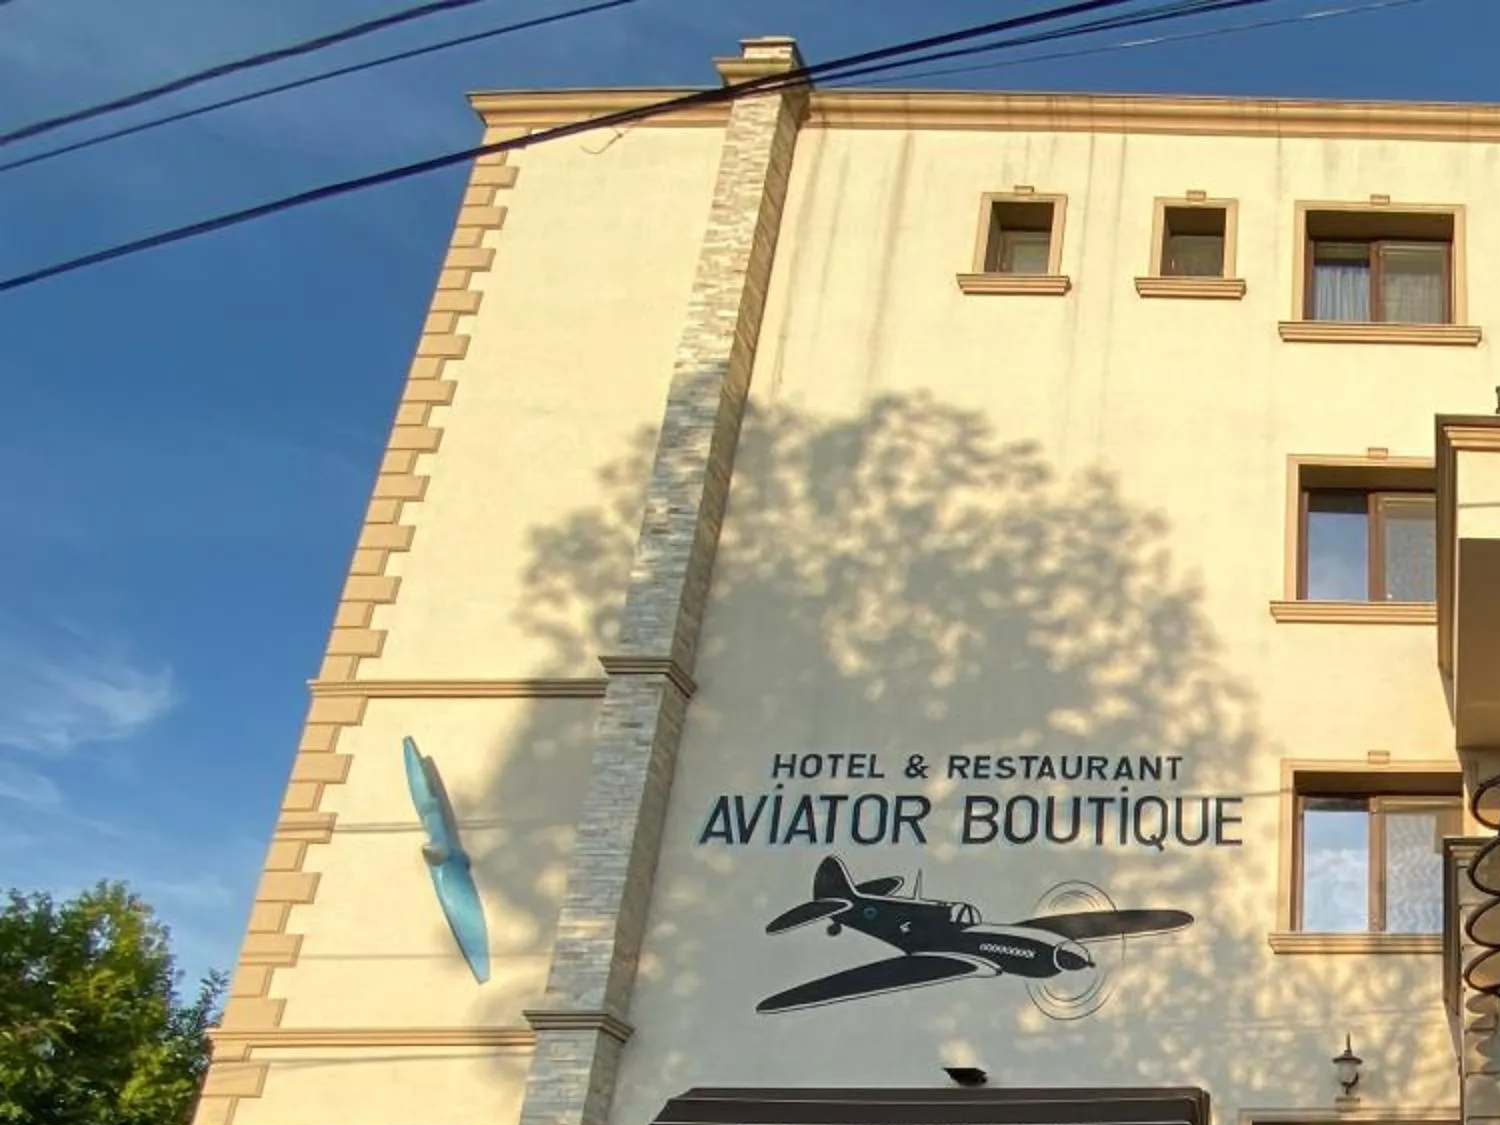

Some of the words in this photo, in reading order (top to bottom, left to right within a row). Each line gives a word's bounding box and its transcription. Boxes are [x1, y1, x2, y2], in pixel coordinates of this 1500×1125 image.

[772, 752, 885, 780] HOTEL
[904, 753, 930, 780] &
[947, 754, 1184, 782] RESTAURANT
